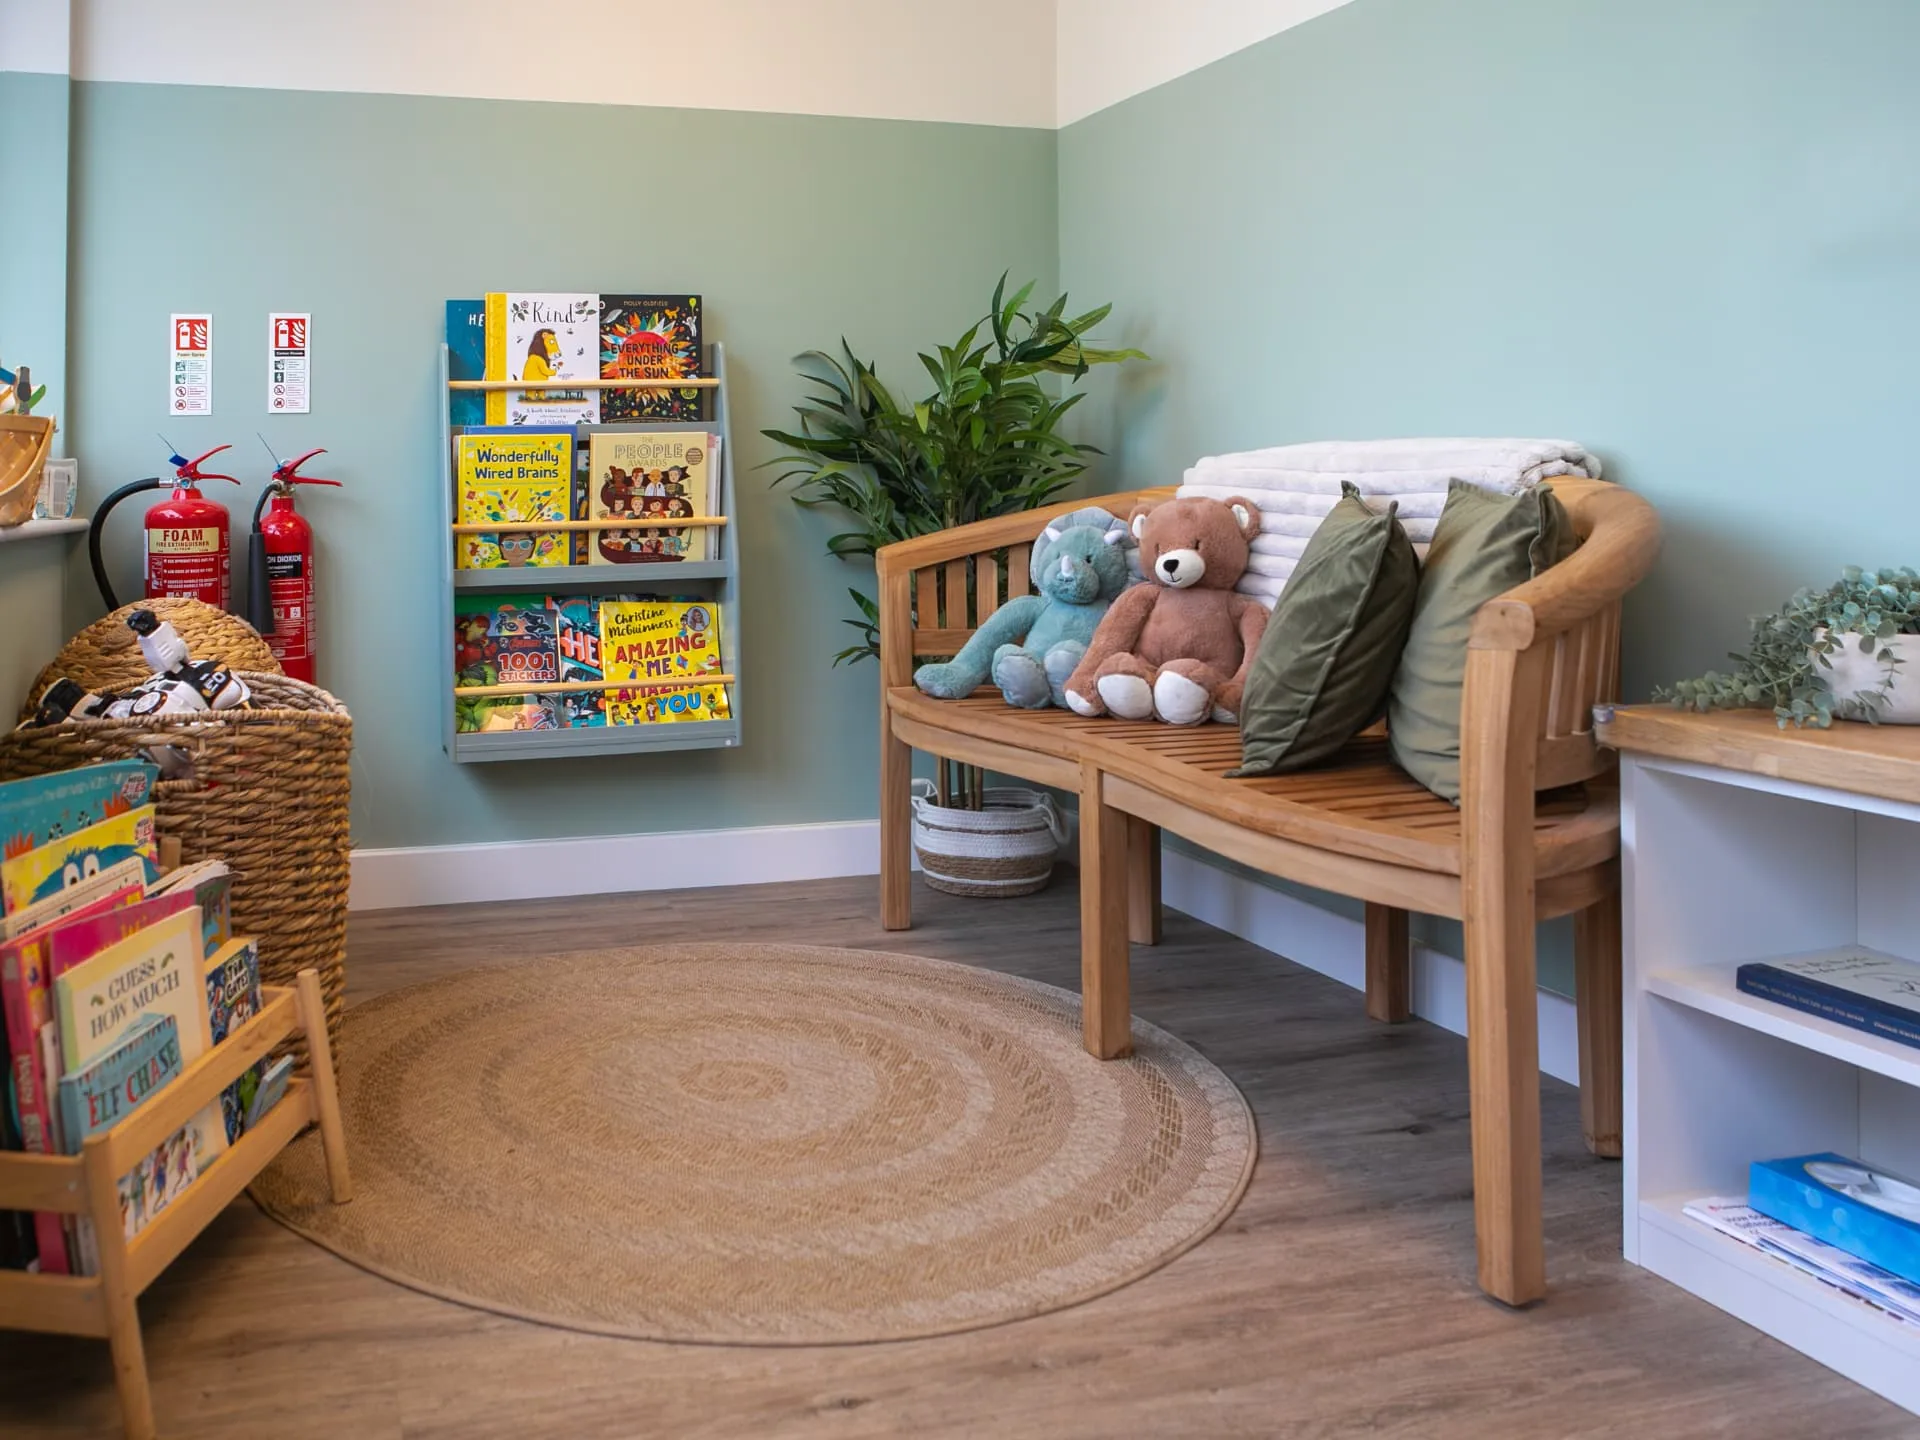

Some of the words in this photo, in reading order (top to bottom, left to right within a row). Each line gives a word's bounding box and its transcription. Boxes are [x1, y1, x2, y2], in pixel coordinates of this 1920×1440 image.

[533, 301, 576, 324] Kind
[611, 343, 679, 354] EVERYTHING
[627, 355, 663, 366] UNDER
[619, 367, 641, 378] THE
[644, 367, 669, 378] SUN
[477, 448, 559, 466] Wonderfully
[614, 444, 684, 459] PEOPLE
[628, 459, 668, 468] AWARDS
[475, 467, 514, 479] Wired
[517, 467, 559, 478] Brains
[163, 529, 204, 541] FOAM
[276, 554, 303, 563] DIOXIDE
[615, 609, 665, 625] Christine
[608, 619, 674, 638] McGuinness
[615, 633, 707, 664] AMAZING
[498, 651, 556, 673] 1001
[647, 657, 673, 678] ME
[499, 671, 557, 682] STICKERS
[656, 692, 702, 716] YOU
[108, 957, 156, 1000] GUESS
[91, 1003, 128, 1039] HOW
[132, 969, 181, 1013] MUCH
[88, 1085, 122, 1129] ELF
[126, 1038, 179, 1104] CHASE
